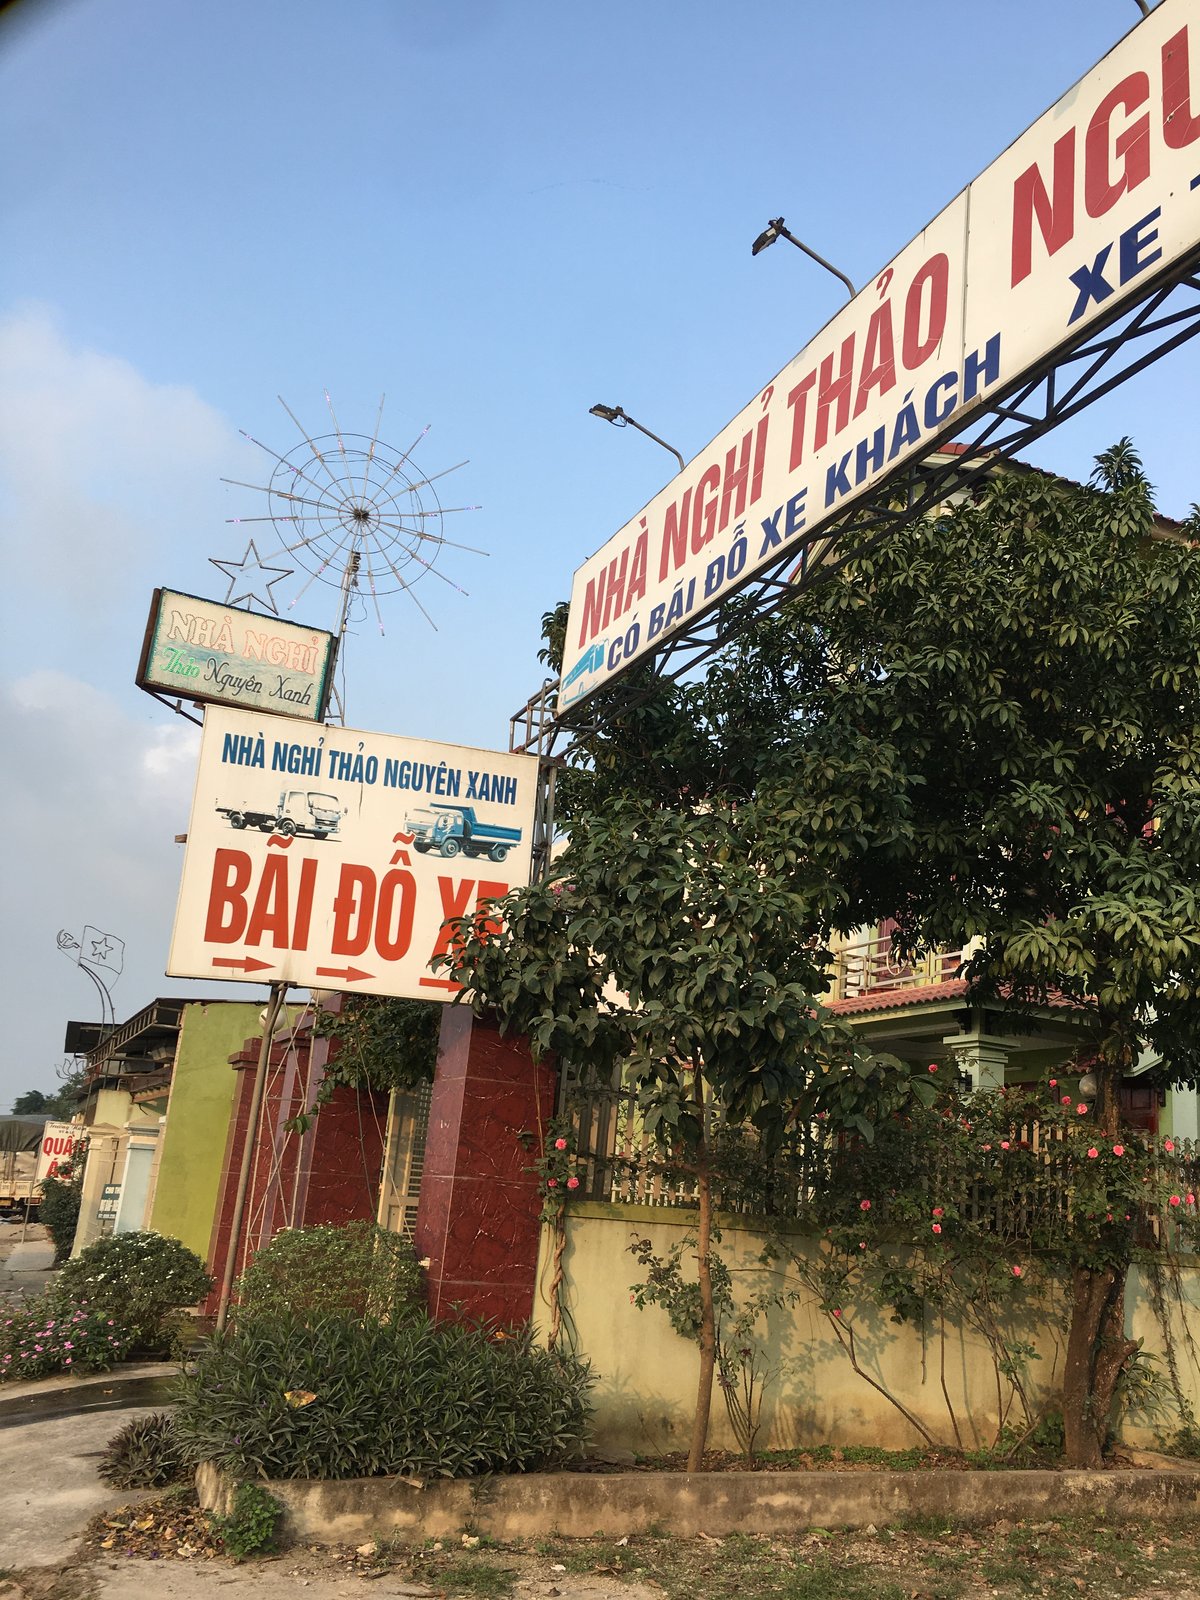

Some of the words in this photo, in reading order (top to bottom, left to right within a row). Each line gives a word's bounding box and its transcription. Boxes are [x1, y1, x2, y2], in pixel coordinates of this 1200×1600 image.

[578, 516, 648, 649] NHÀ
[658, 385, 774, 583] NGHỈ
[787, 253, 949, 473] THẢO
[607, 612, 640, 671] CÓ
[647, 577, 696, 643] BÃI
[704, 520, 748, 600] ĐỖ
[758, 486, 808, 560] XE
[825, 332, 1000, 509] KHÁCH
[1067, 205, 1162, 327] XE
[159, 647, 200, 679] Thảo
[204, 657, 263, 696] Nguyên
[269, 675, 314, 705] Xanh
[167, 610, 235, 654] NHÀ
[243, 630, 318, 675] NGHỈ
[222, 732, 265, 769] NHÀ
[272, 737, 324, 777] NGHỈ
[329, 742, 378, 784] THẢO
[384, 761, 461, 797] NGUYÊN
[466, 770, 518, 805] XANH
[204, 835, 319, 952] BÃI
[331, 832, 417, 961] ĐỖ
